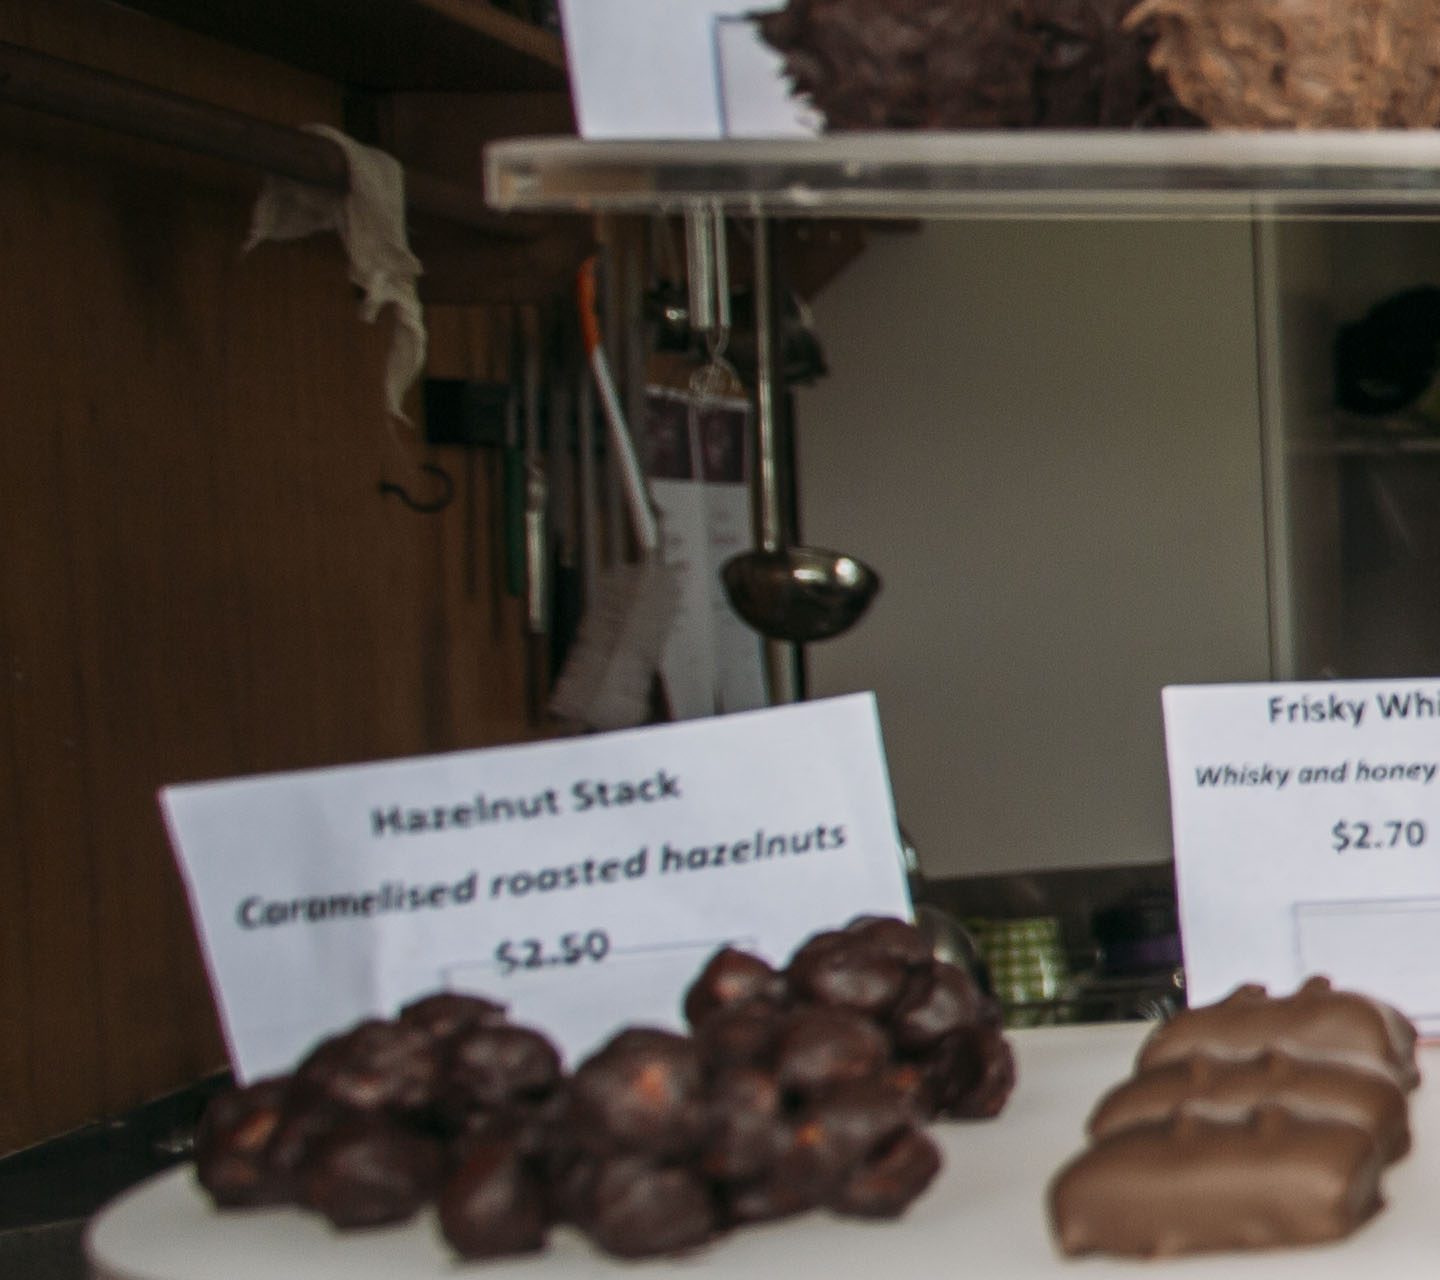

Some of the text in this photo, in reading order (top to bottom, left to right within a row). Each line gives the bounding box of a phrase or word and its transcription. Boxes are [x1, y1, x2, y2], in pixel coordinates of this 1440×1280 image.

[1268, 695, 1366, 727] Frisky
[1195, 762, 1290, 790] Whisky
[1298, 759, 1347, 785] and
[1356, 758, 1436, 784] honey
[371, 768, 681, 837] Hazelnut Stack
[1331, 819, 1428, 852] $2.70
[237, 822, 847, 930] Caramelised roasted hazelnuts
[495, 930, 609, 974] $2.50
